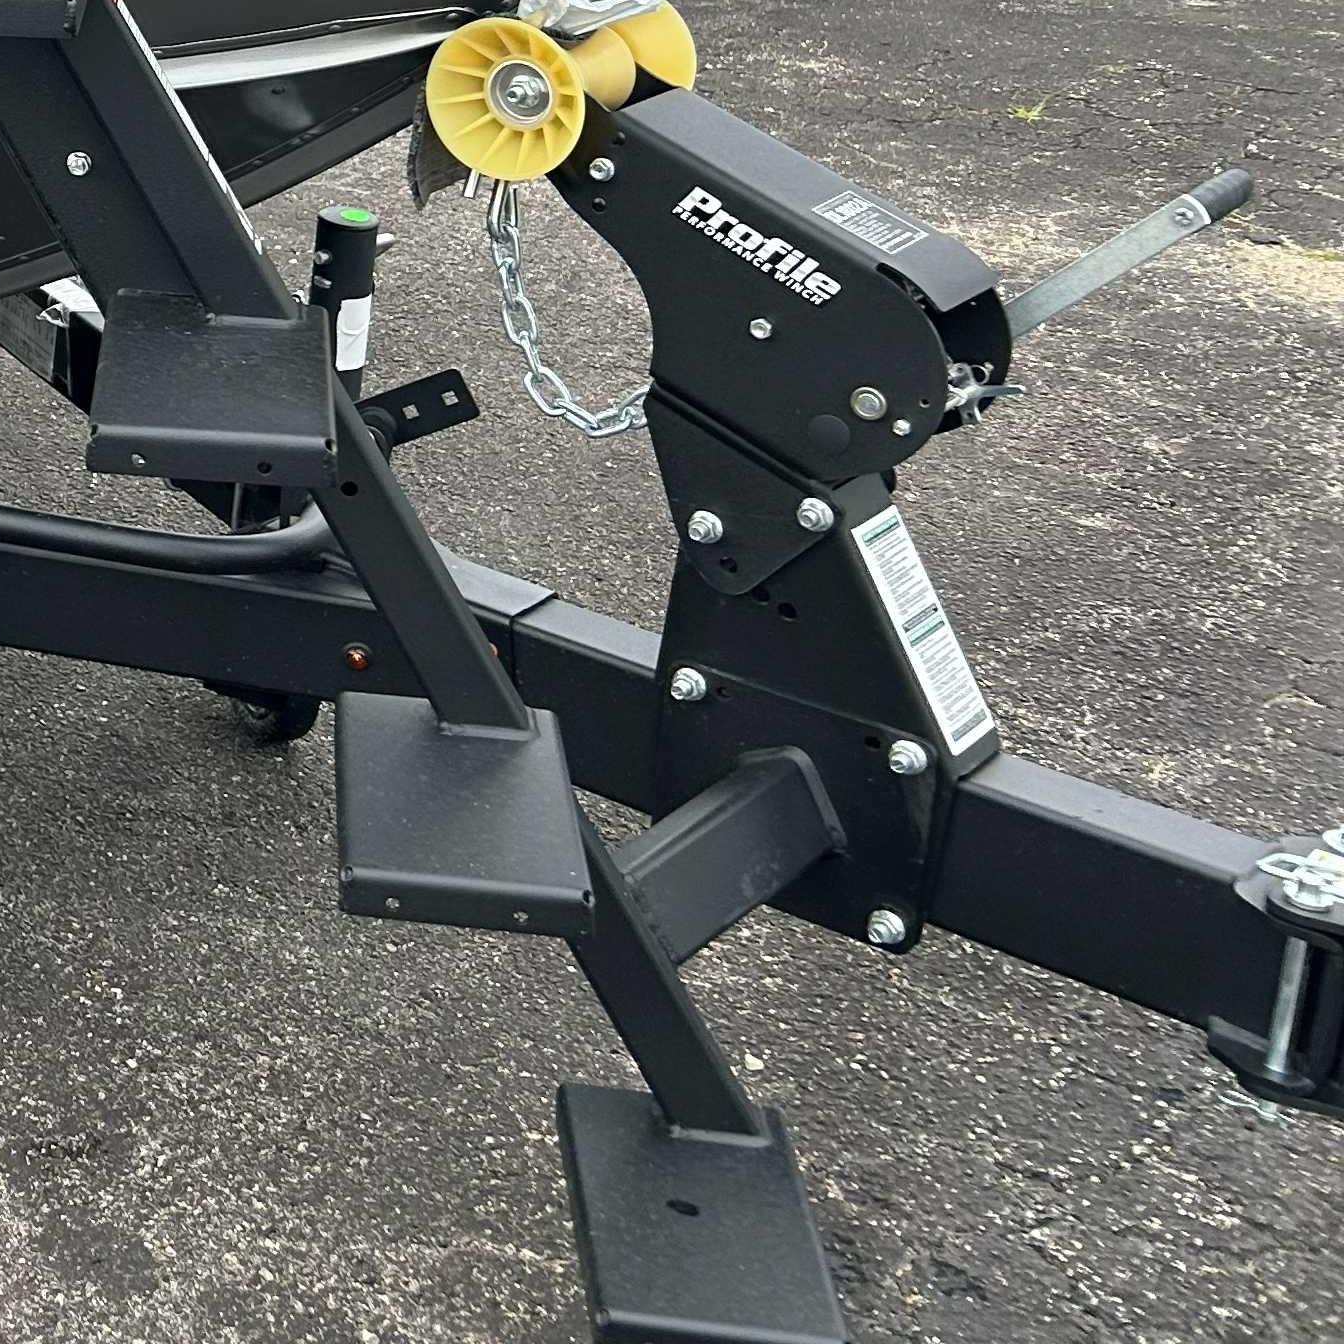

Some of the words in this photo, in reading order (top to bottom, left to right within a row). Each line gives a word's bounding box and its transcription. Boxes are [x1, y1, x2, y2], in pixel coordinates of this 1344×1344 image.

[671, 205, 773, 274] PERFORMANCE
[774, 270, 825, 306] WINCH
[678, 186, 842, 300] Profile
